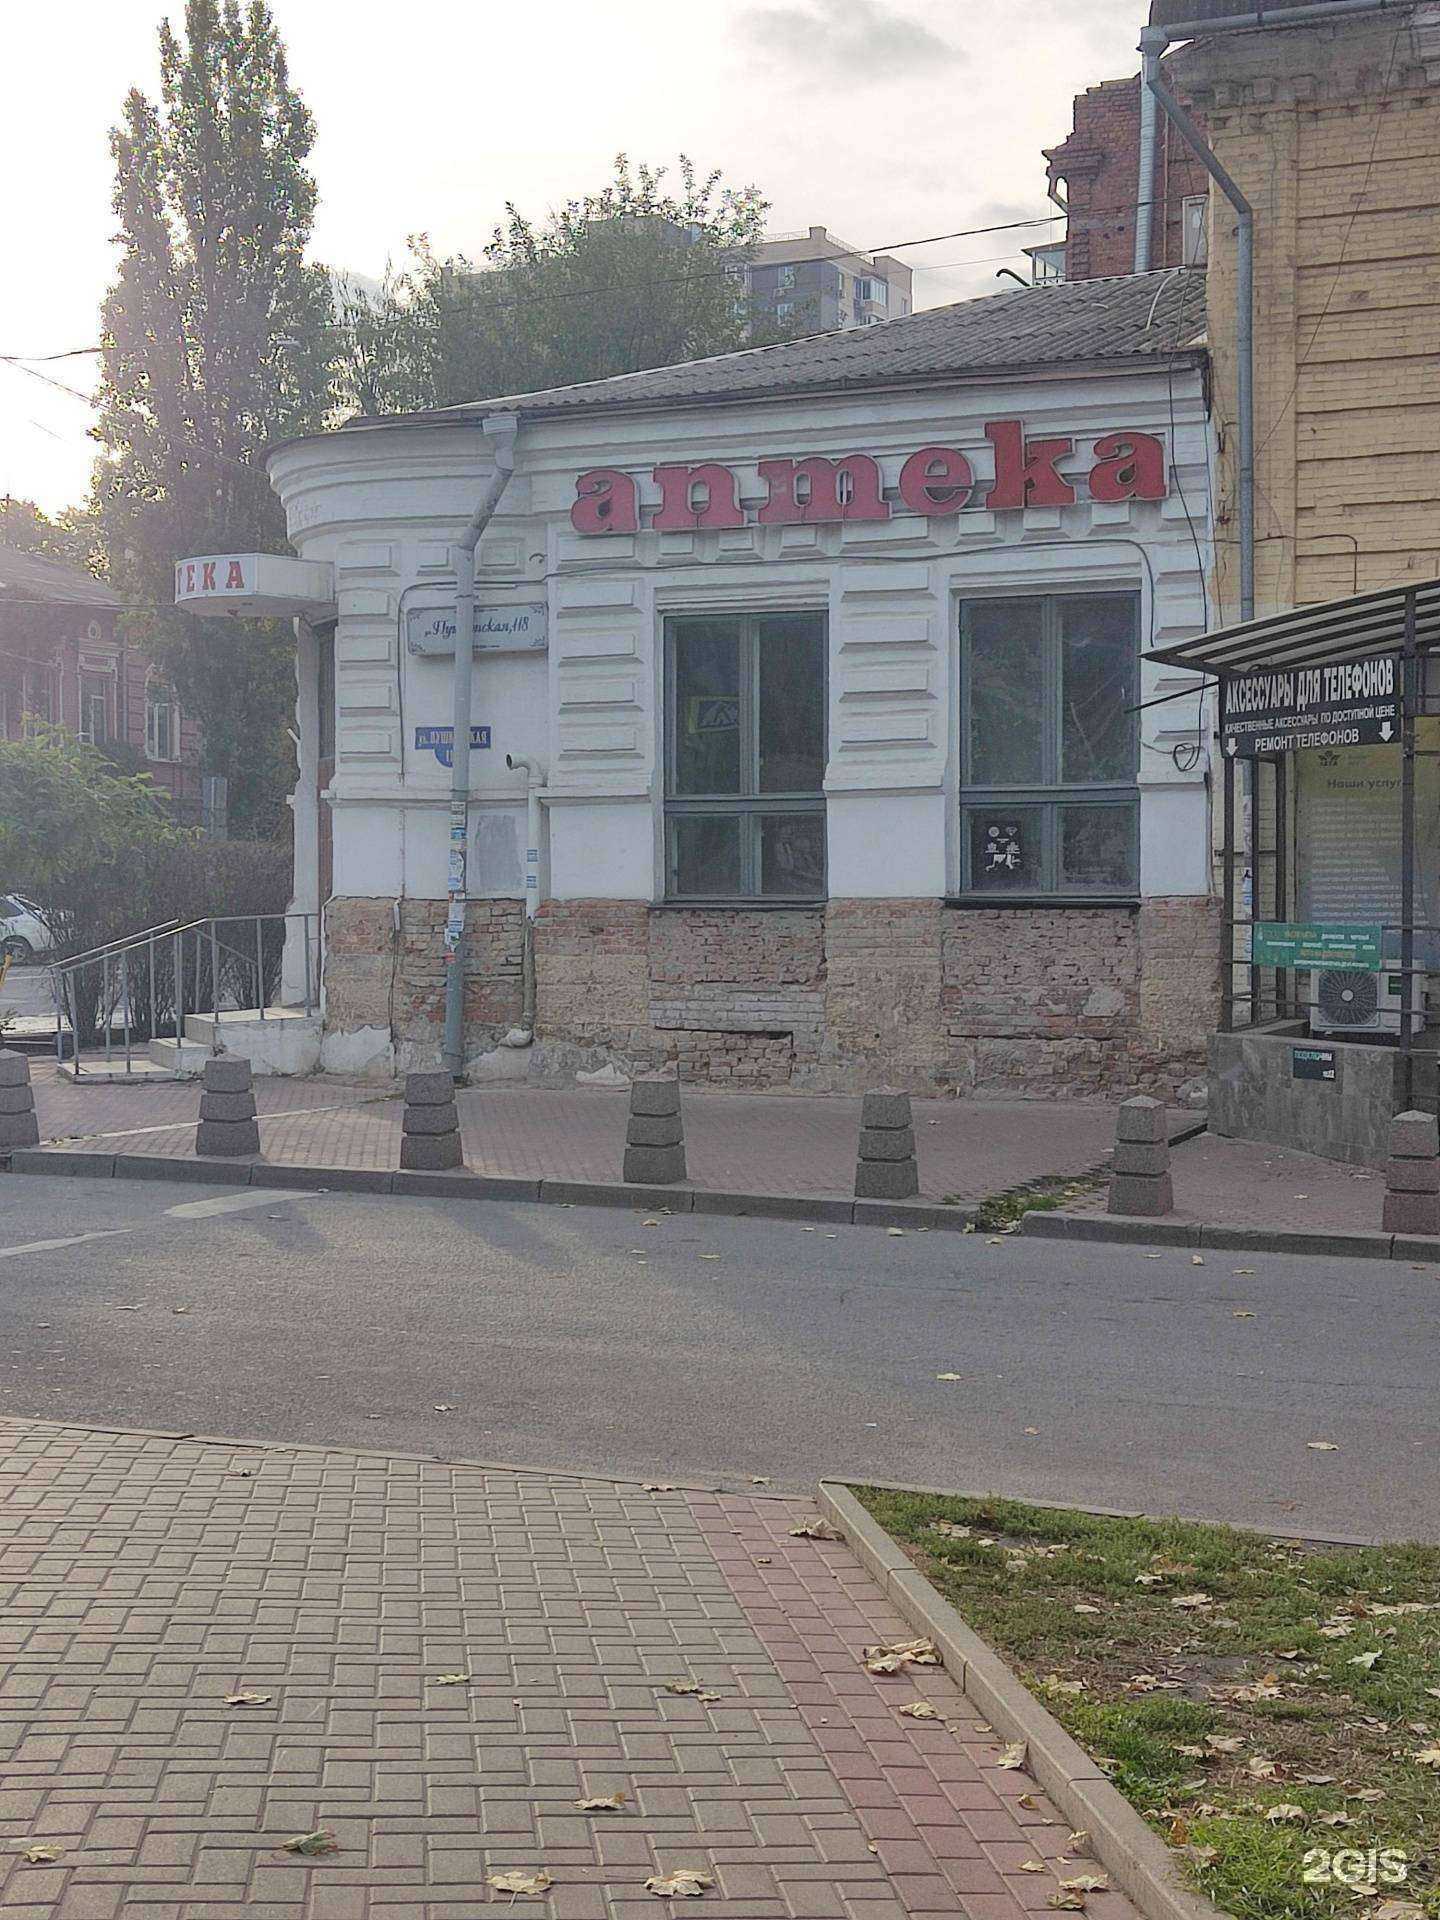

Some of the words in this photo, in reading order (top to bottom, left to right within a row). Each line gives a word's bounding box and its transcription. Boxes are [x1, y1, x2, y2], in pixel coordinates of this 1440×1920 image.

[1225, 673, 1294, 714] АКСЕССУАРЫ
[1296, 670, 1321, 712] ДЛЯ
[1323, 659, 1394, 702] ТЕЛЕФОНОВ
[1224, 718, 1274, 734] КАЧЕСТВЕННЫЕ
[1274, 713, 1320, 729] АКСЕССУАРЫ
[1320, 712, 1331, 724] ПО
[1331, 705, 1374, 724] ДОСТУПНОЙ
[1375, 704, 1396, 718] ЦЕНЕ
[1254, 734, 1294, 753] РЕМОНТ
[1295, 728, 1360, 748] ТЕЛЕФОНОВ
[1327, 778, 1364, 788] Наши
[1366, 777, 1403, 791] услуг
